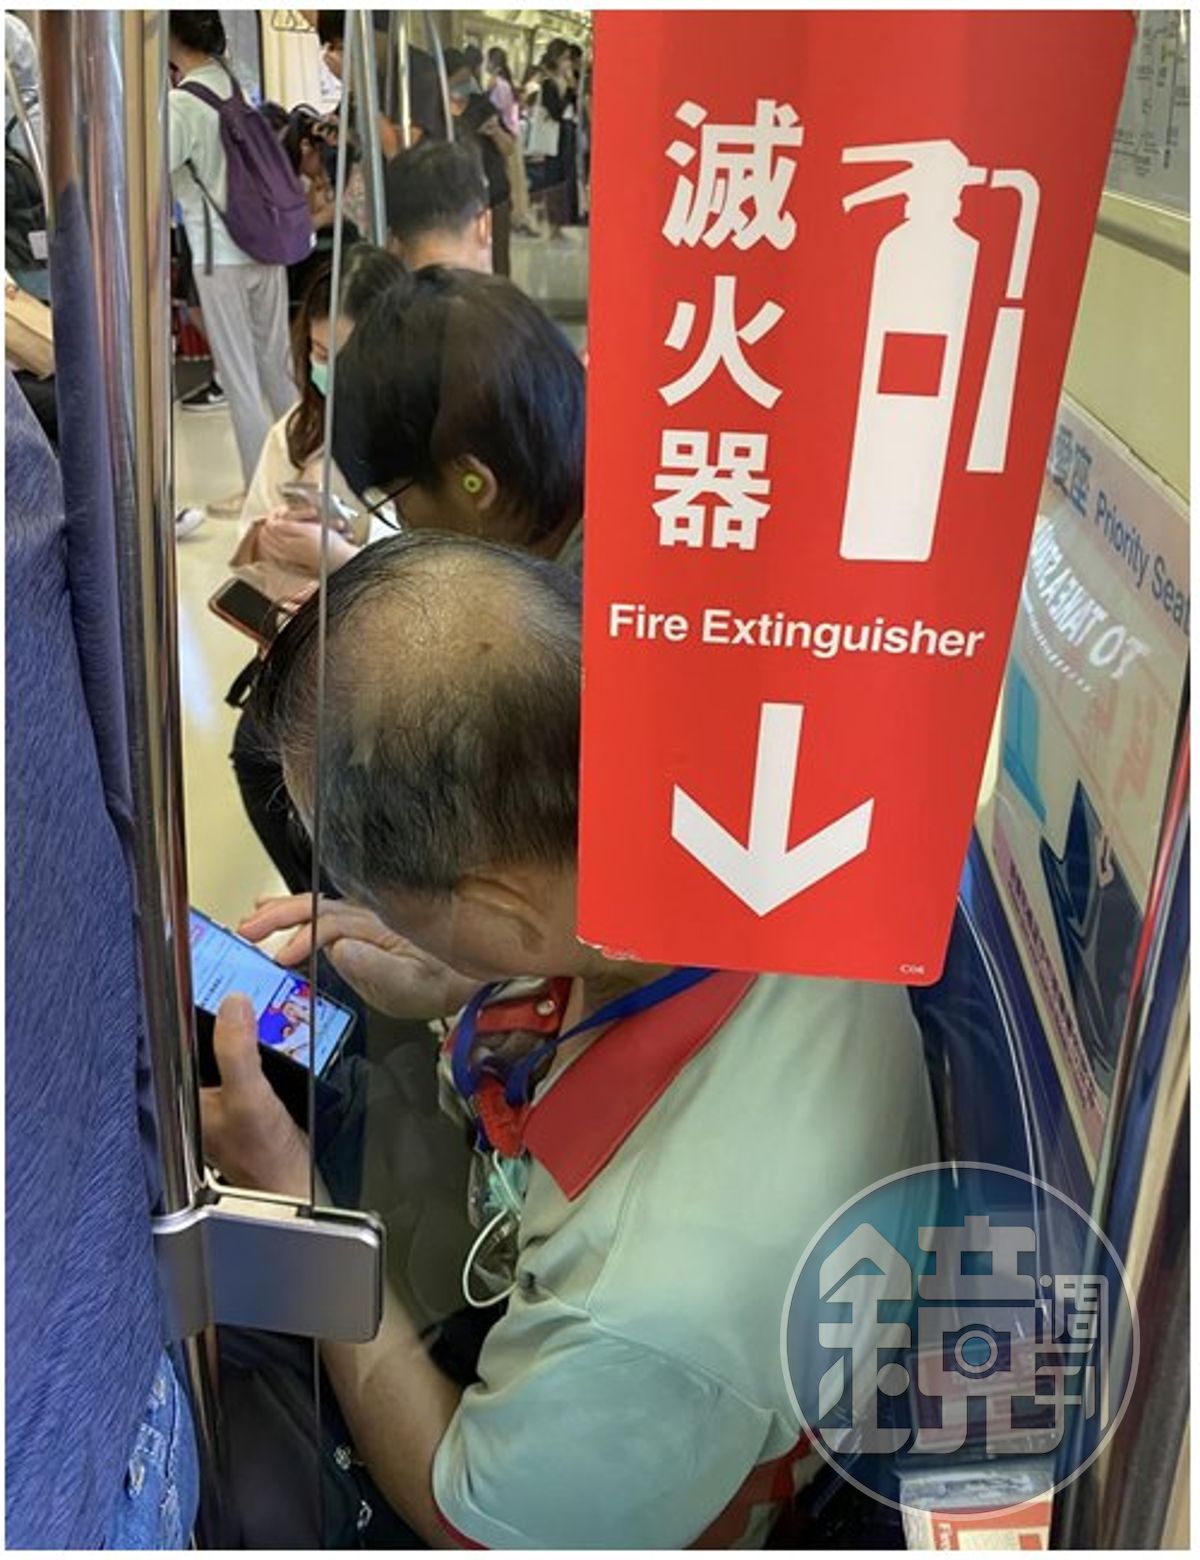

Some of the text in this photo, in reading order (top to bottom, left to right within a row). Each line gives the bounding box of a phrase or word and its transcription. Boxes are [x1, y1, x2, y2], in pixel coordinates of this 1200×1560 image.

[652, 99, 805, 550] 滅火器
[1095, 488, 1150, 590] Priority
[608, 603, 985, 660] Fire Extinguisher
